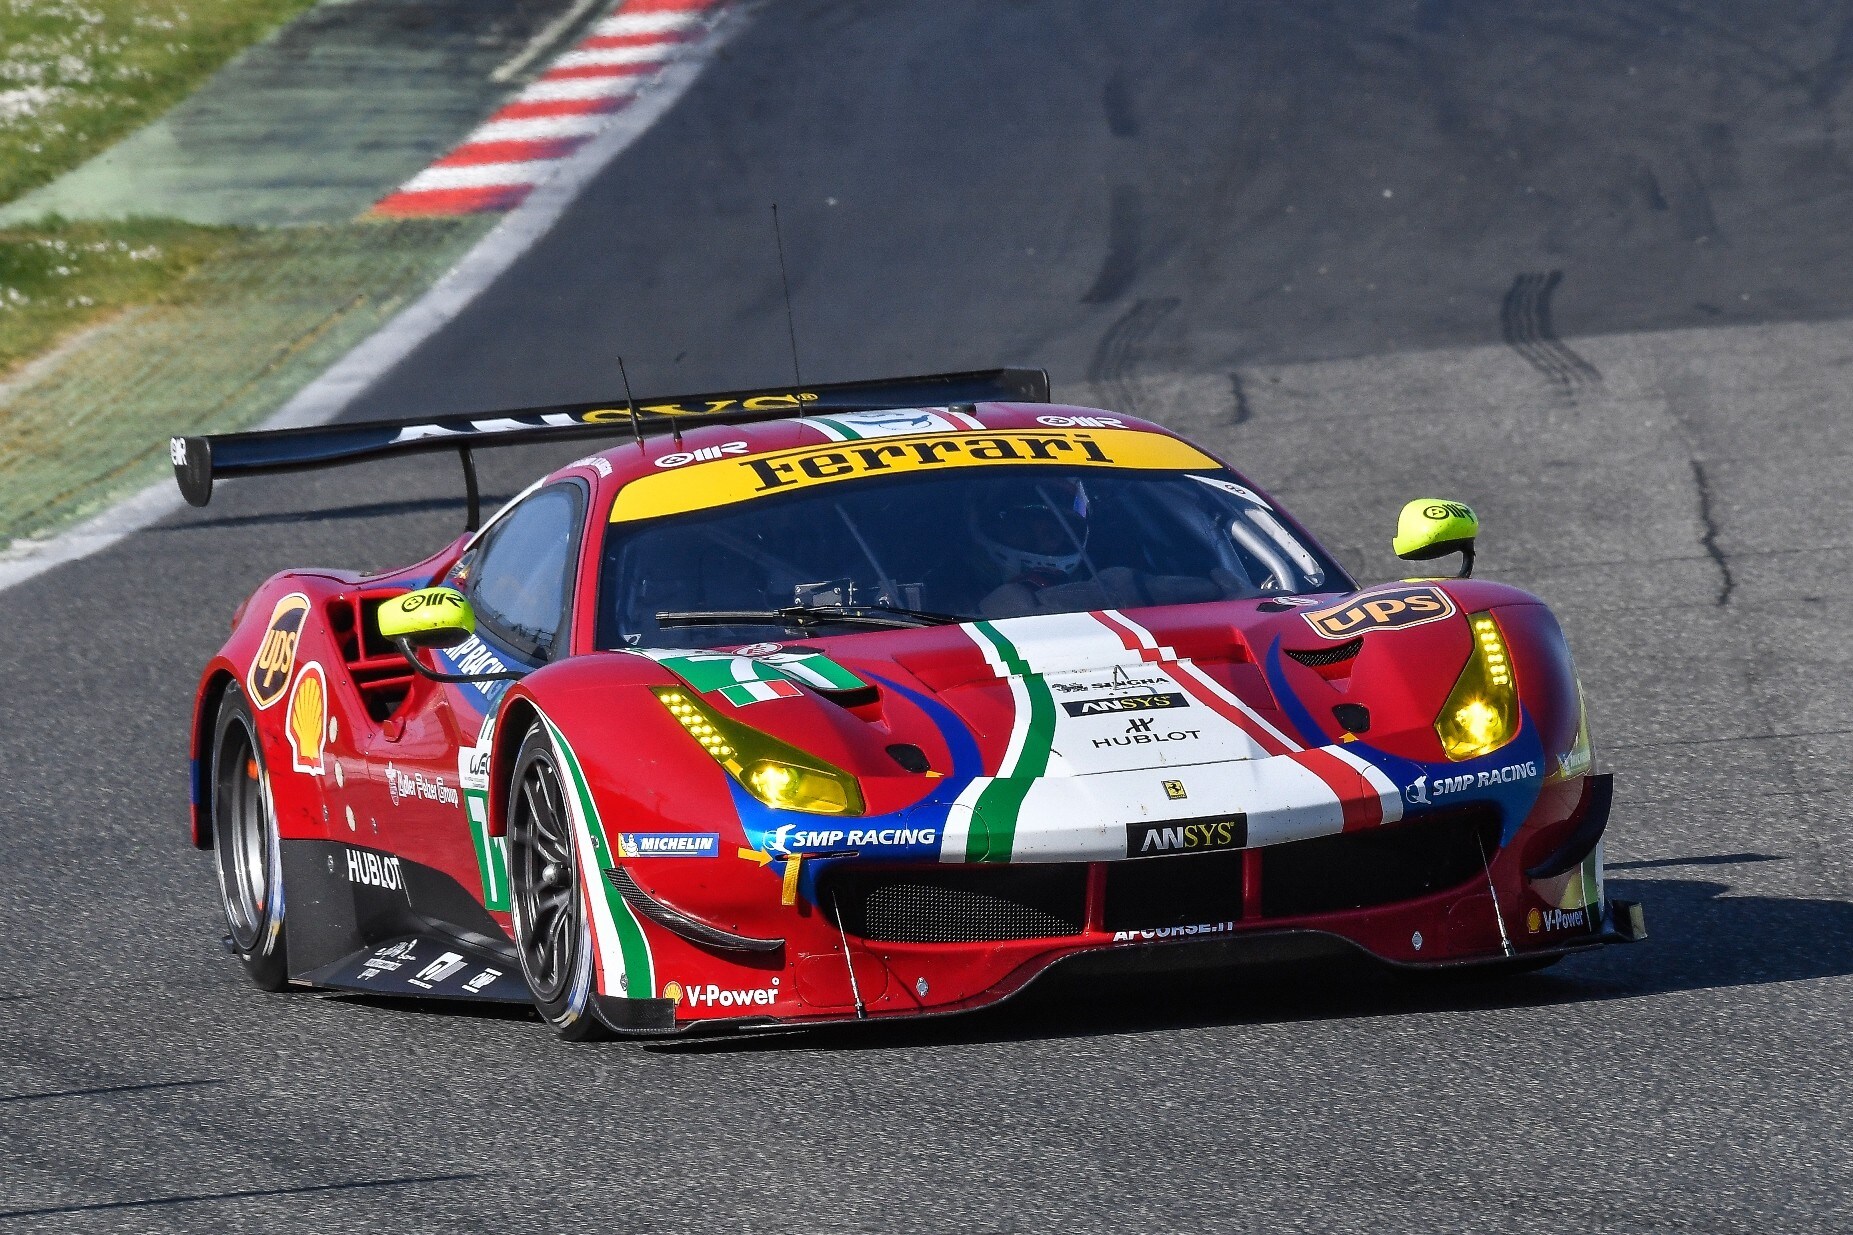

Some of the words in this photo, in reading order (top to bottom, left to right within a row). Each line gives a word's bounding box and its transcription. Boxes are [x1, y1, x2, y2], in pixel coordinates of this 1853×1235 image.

[739, 432, 1115, 493] Ferrari
[1082, 696, 1171, 713] ANSYS
[1092, 730, 1201, 748] HUBLOT
[1433, 774, 1475, 796] SMP
[1477, 761, 1537, 788] RACING
[640, 838, 714, 850] MICHELIN
[793, 829, 844, 847] SMP
[847, 829, 936, 846] RACING
[1141, 822, 1232, 852] ANSYS
[346, 848, 402, 890] HUBLOT
[1543, 909, 1583, 932] V-Power
[686, 984, 778, 1007] V-Power
